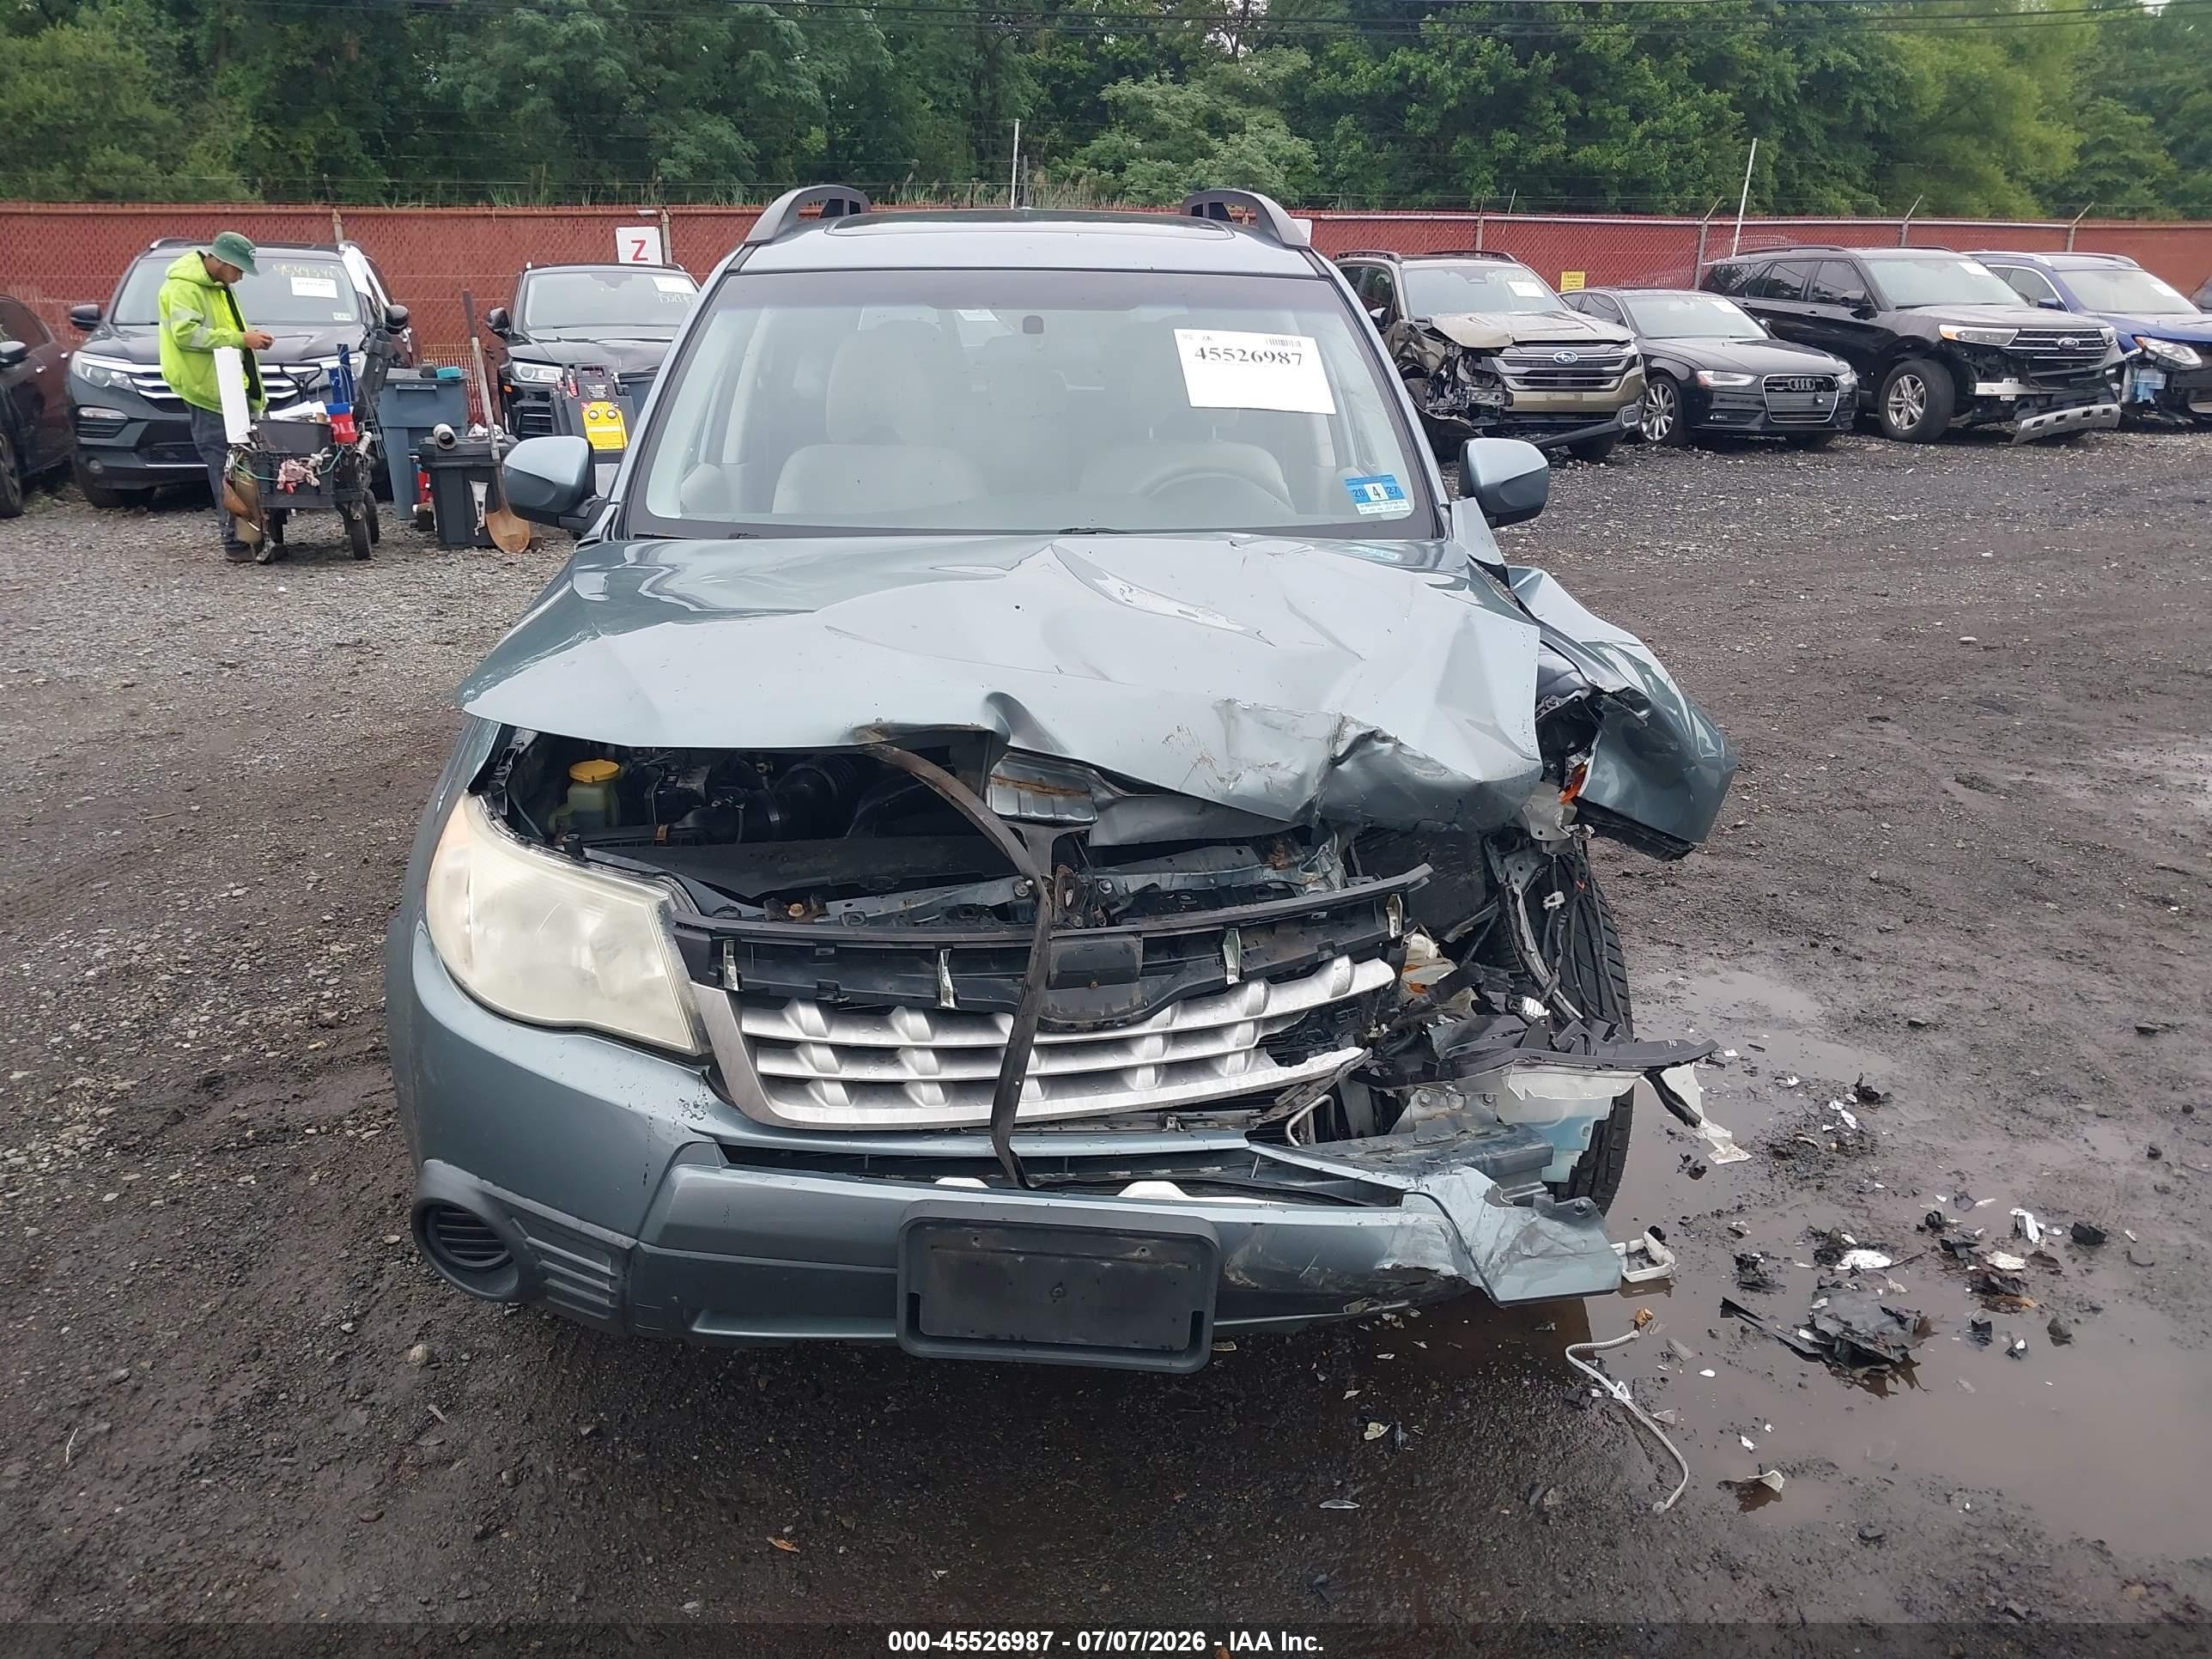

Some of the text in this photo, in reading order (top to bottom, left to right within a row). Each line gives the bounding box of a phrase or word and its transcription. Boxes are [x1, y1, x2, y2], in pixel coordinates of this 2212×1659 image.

[630, 239, 648, 261] Z
[1194, 346, 1303, 367] 45526987
[1371, 485, 1382, 499] 4
